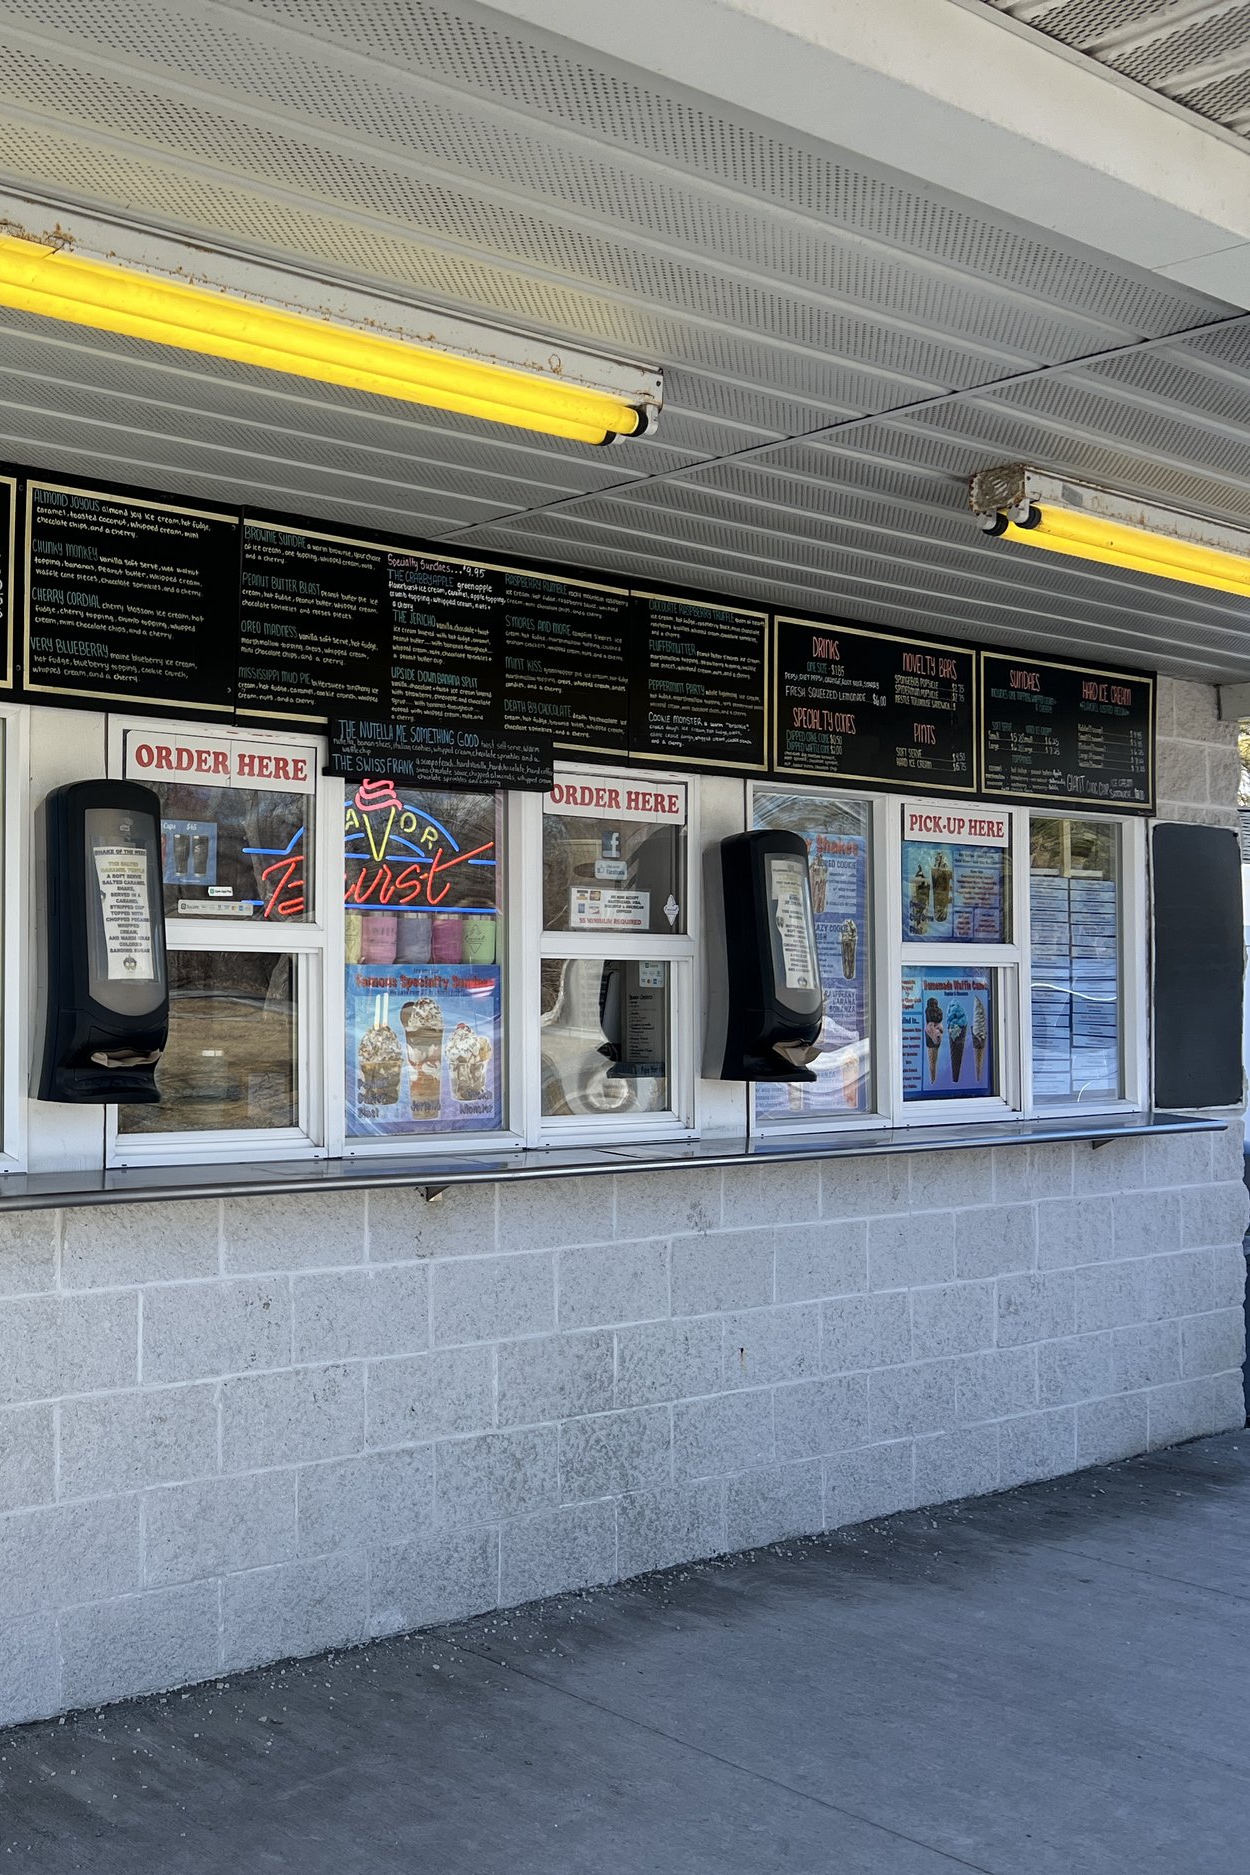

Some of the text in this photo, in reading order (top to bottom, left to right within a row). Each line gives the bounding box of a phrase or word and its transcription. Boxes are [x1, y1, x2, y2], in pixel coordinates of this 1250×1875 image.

[34, 489, 68, 508] ALMOND
[32, 587, 100, 608] CHERRY CORDIAL
[241, 620, 261, 633] OREO
[30, 637, 109, 658] VERY BLUEBERRY
[812, 636, 840, 660] DRINKS
[903, 652, 957, 680] NOVELTY BARS
[785, 685, 837, 699] FRESH SQUEEZED
[1010, 670, 1040, 692] SUNDAES
[1082, 681, 1131, 706] HARD ICE CREAM
[793, 707, 833, 732] SPECIALTY
[338, 720, 356, 739] THE
[359, 721, 393, 739] NUTELLA
[457, 731, 480, 748] GOOD
[913, 723, 936, 744] PINTS
[135, 744, 308, 781] ORDER HERE
[332, 754, 415, 776] THE SWISS FRANK
[551, 784, 679, 814] ORDER HERE
[909, 814, 1004, 838] PICK-UP HERE
